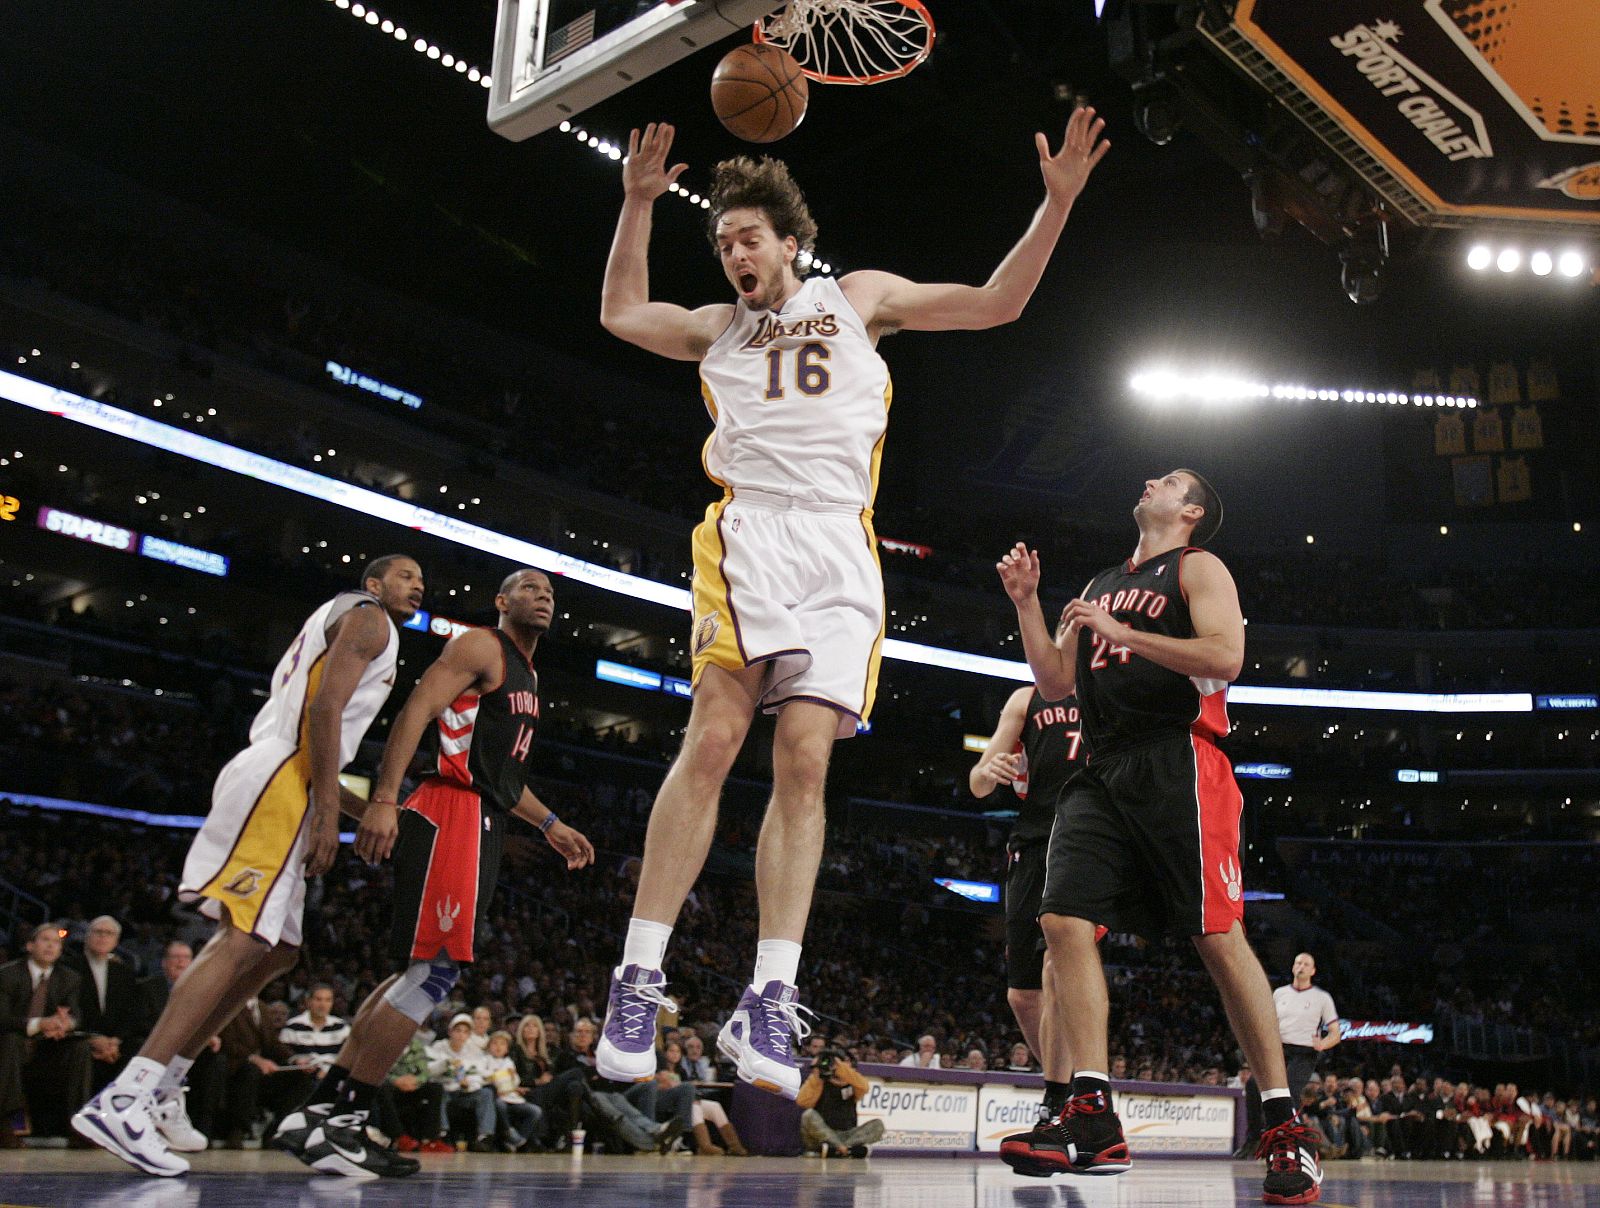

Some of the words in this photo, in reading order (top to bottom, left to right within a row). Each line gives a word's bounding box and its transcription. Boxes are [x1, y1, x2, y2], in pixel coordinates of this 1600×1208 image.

[1329, 26, 1421, 97] SPORT
[1397, 95, 1487, 161] CHALET
[763, 340, 832, 401] 16
[46, 508, 132, 550] STAPLES
[510, 721, 535, 763] 14
[1064, 730, 1082, 761] 7
[1126, 1097, 1229, 1125] CreditReport.com
